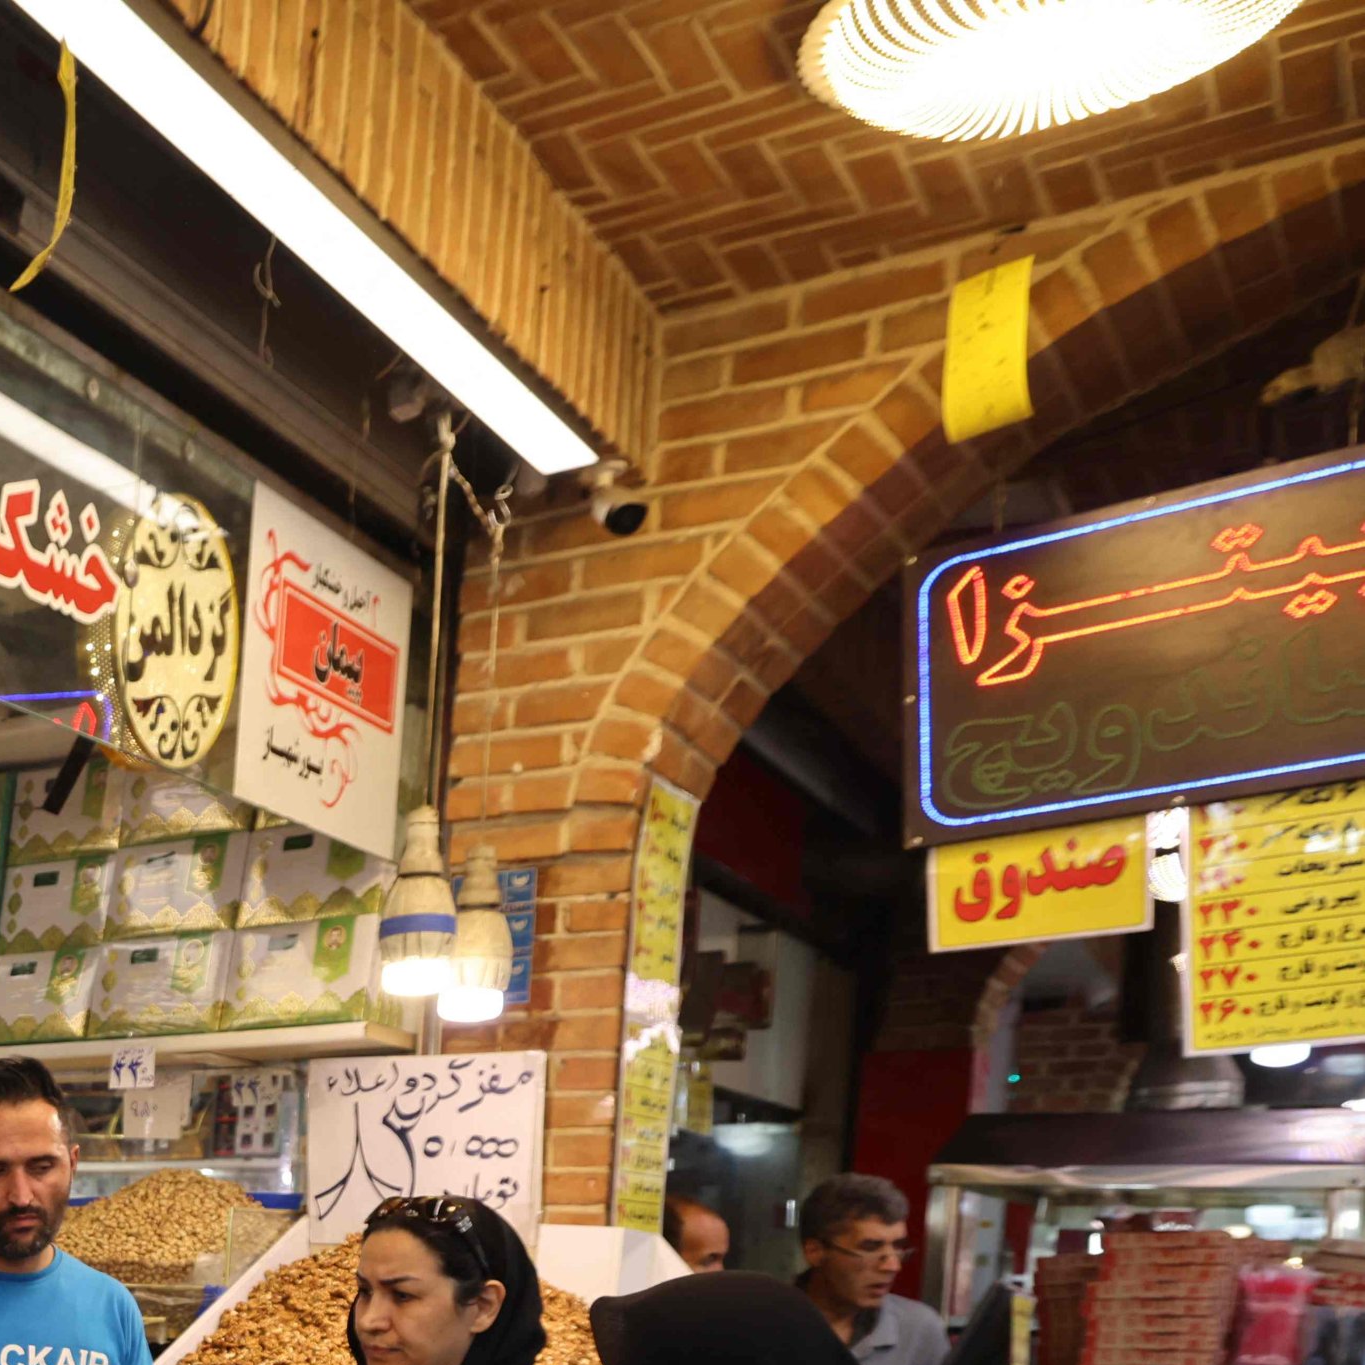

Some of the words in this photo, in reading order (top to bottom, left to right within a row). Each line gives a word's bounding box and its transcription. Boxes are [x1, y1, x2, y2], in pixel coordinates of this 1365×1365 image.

[946, 523, 1365, 687] یتزا
[313, 621, 365, 706] پیمان
[954, 837, 1128, 923] صندوق
[400, 1058, 476, 1115] گردو
[458, 1063, 535, 1113] مغز
